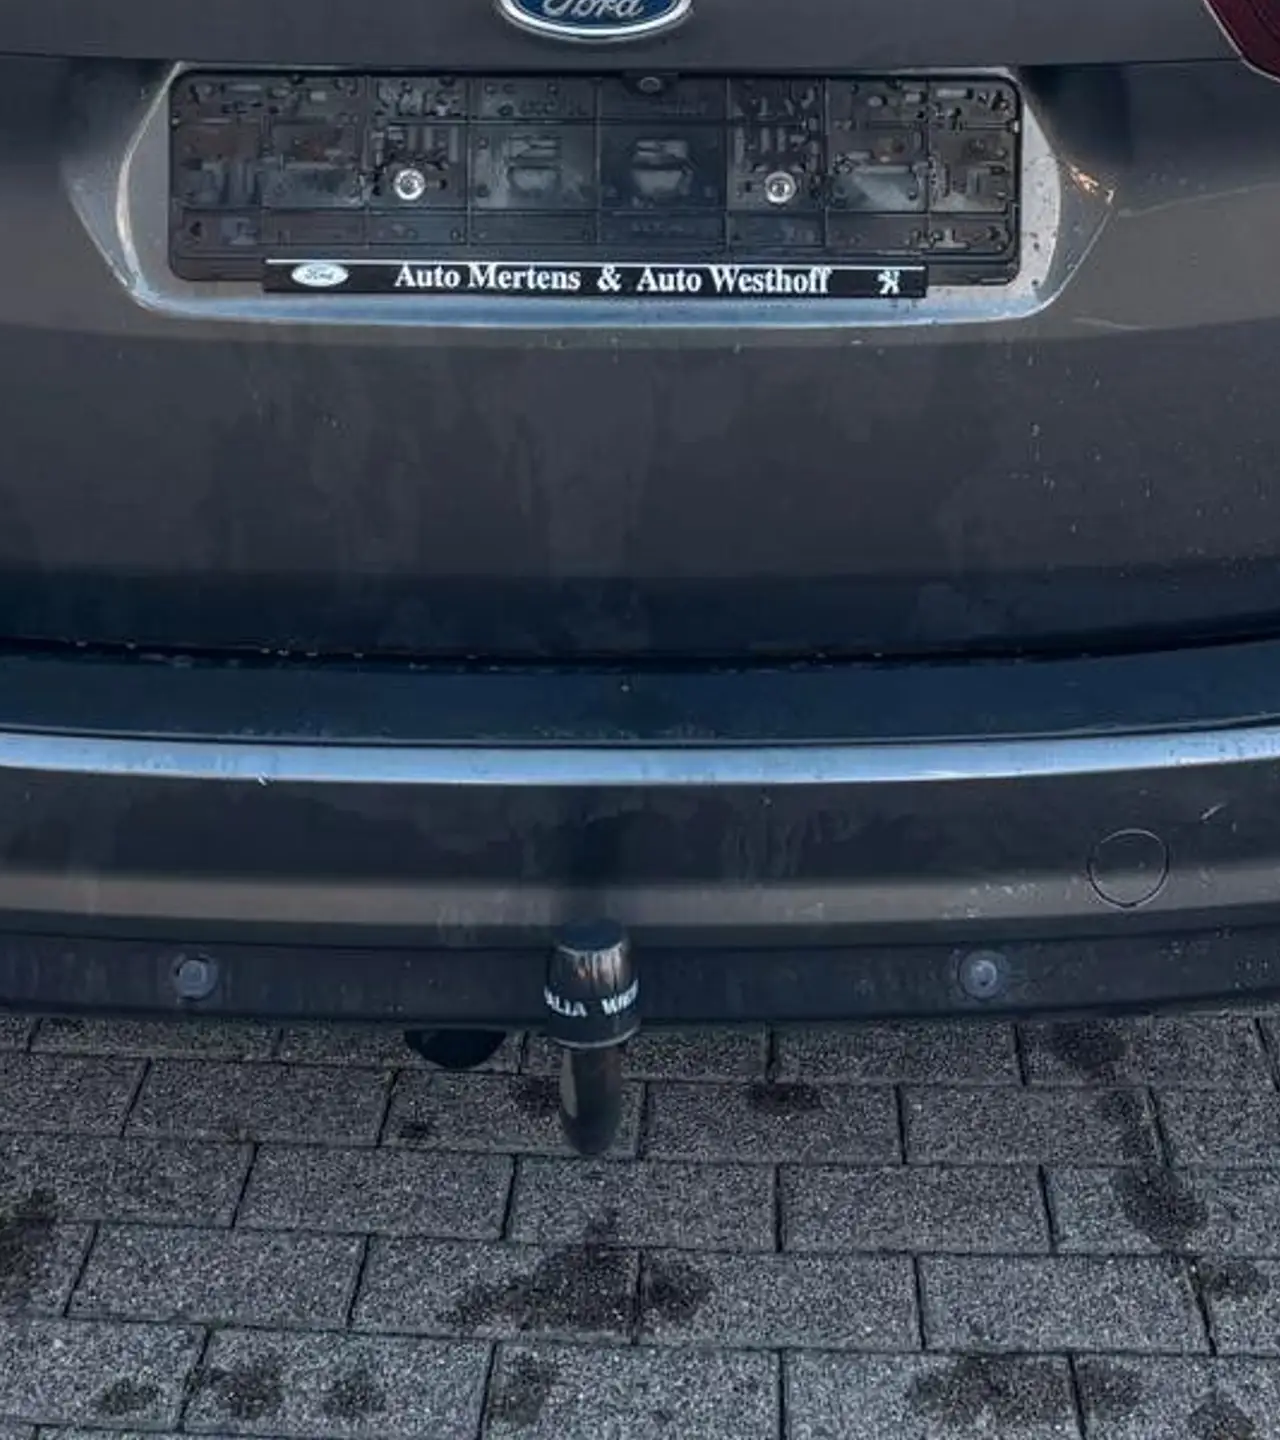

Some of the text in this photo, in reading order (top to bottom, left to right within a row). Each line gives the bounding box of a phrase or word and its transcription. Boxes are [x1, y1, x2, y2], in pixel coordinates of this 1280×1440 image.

[395, 262, 832, 294] Auto Mertens & Auto Westhoff
